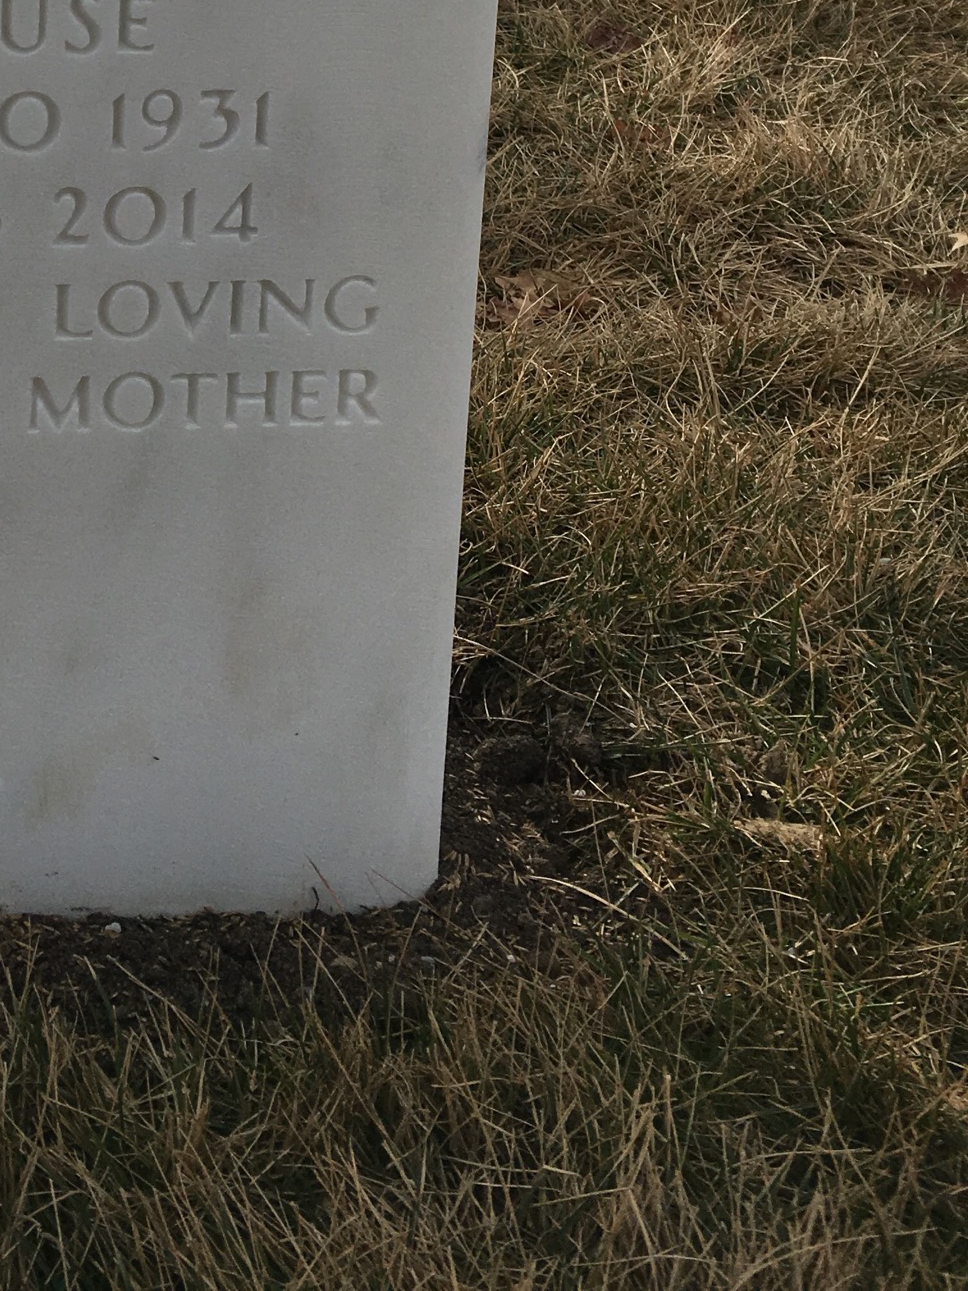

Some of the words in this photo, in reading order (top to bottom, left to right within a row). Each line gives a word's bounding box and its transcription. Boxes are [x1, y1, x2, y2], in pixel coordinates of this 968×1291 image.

[109, 87, 274, 151] 1931
[52, 182, 259, 247] 2014
[53, 275, 381, 342] LOVING
[28, 368, 382, 435] MOTHER
